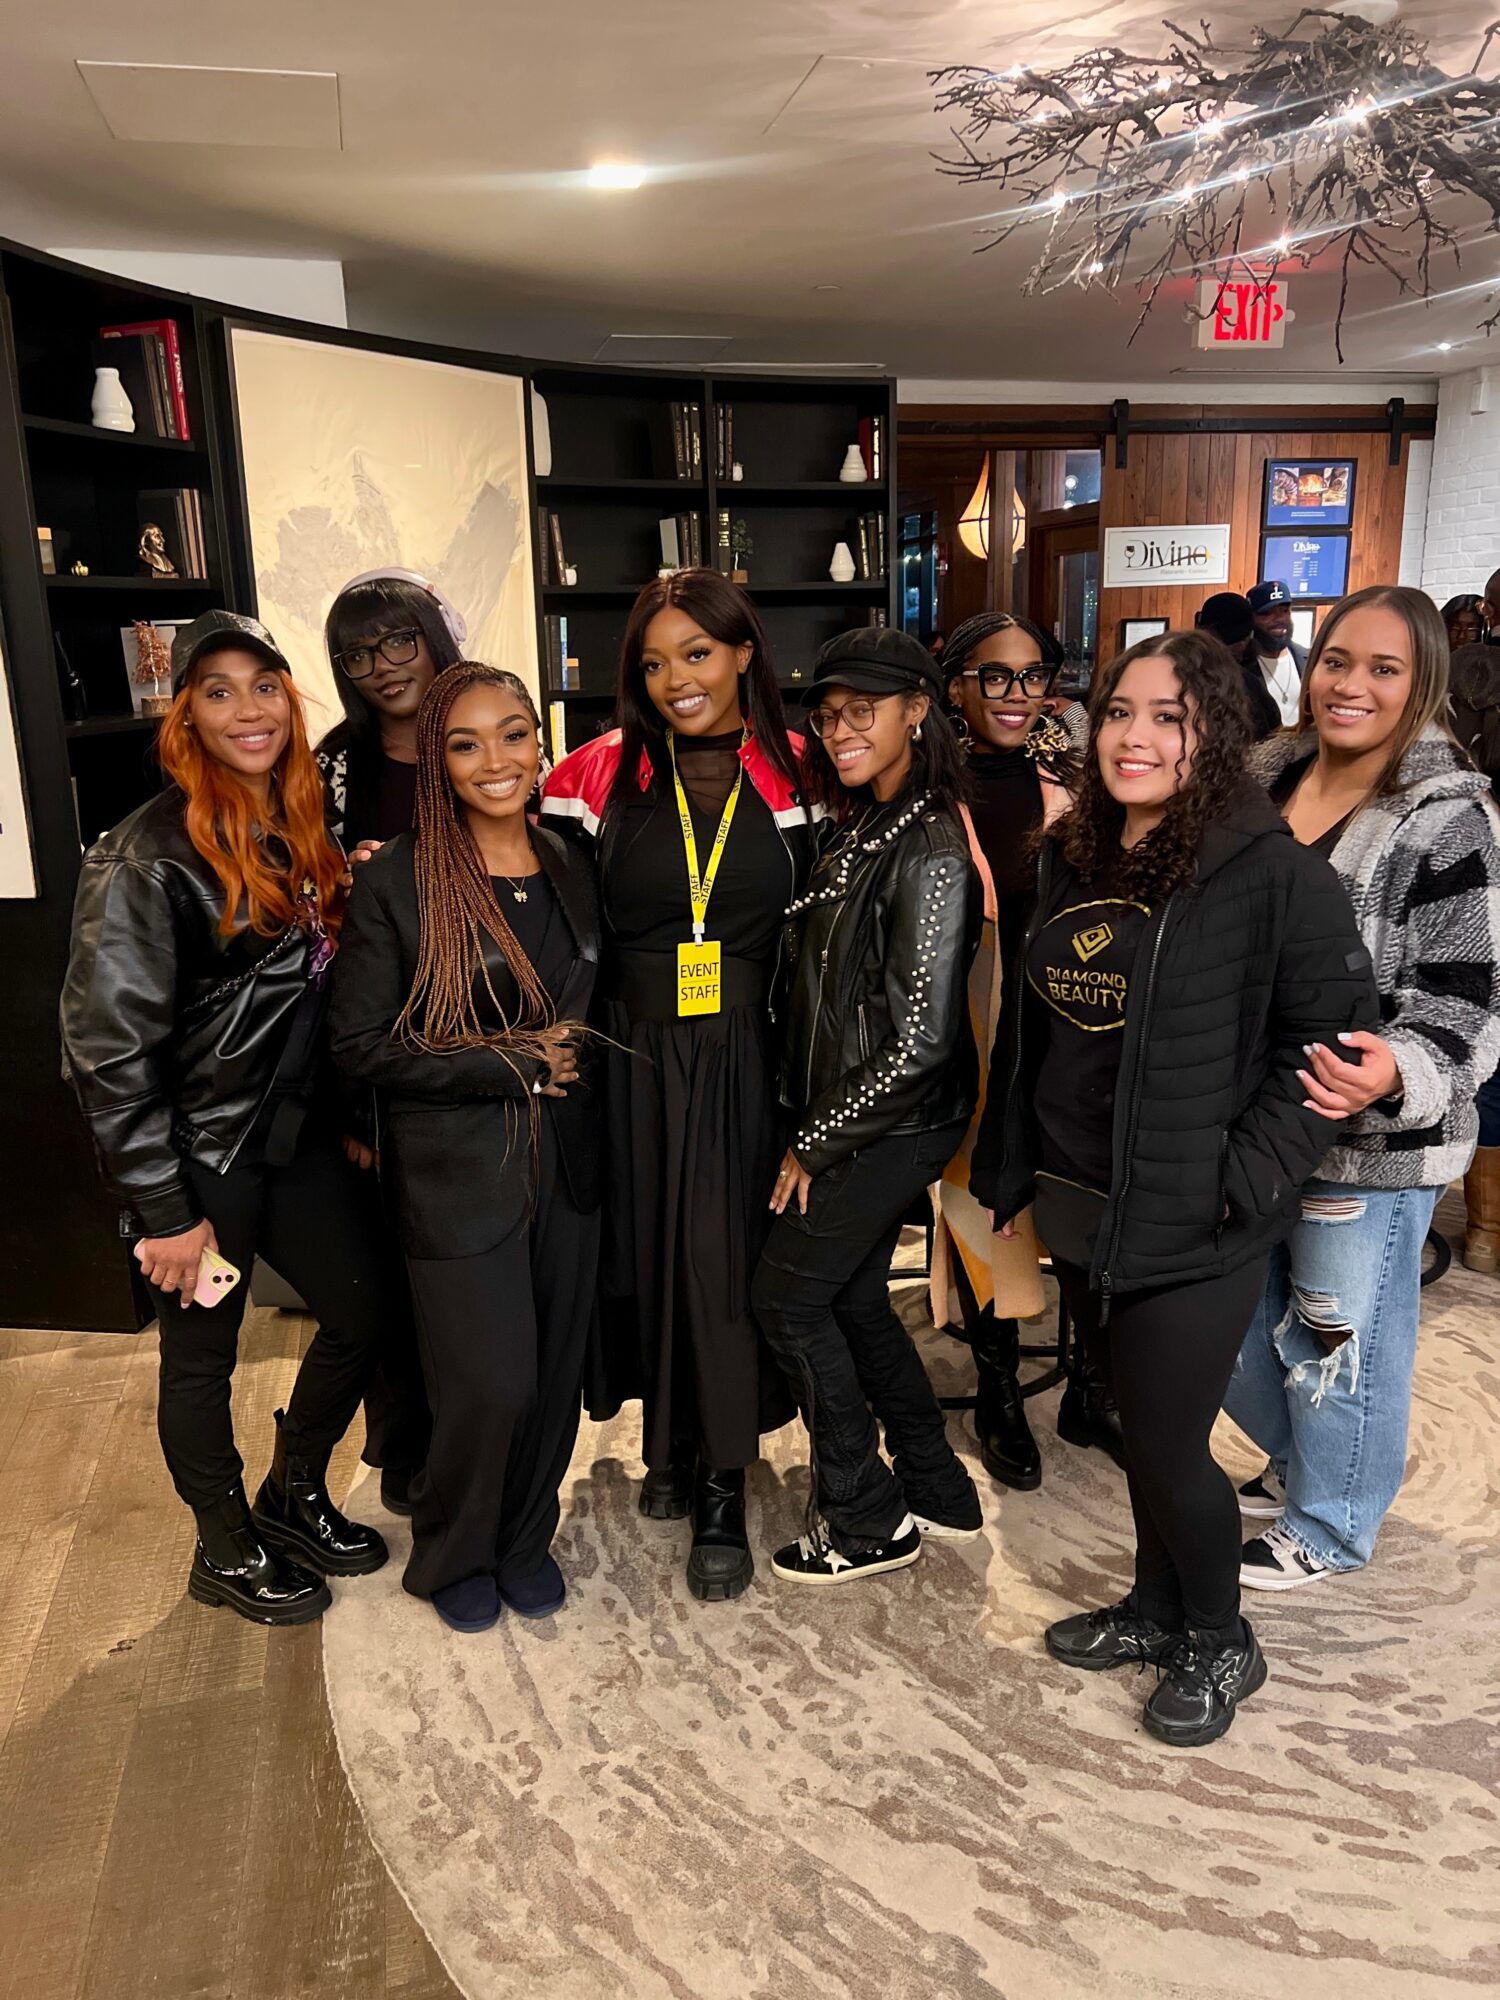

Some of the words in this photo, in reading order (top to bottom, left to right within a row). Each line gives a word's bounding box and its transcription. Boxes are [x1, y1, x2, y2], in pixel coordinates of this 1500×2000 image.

[1214, 284, 1277, 340] EXIT
[1124, 539, 1208, 568] Divino
[681, 812, 693, 839] STAFF
[716, 818, 730, 844] STAFF
[690, 873, 700, 902] STAFF
[700, 876, 712, 904] STAFF
[680, 962, 719, 978] EVENT
[1045, 966, 1127, 989] DIAMOND
[681, 984, 719, 1001] STAFF
[1047, 982, 1126, 1012] BEAUTY
